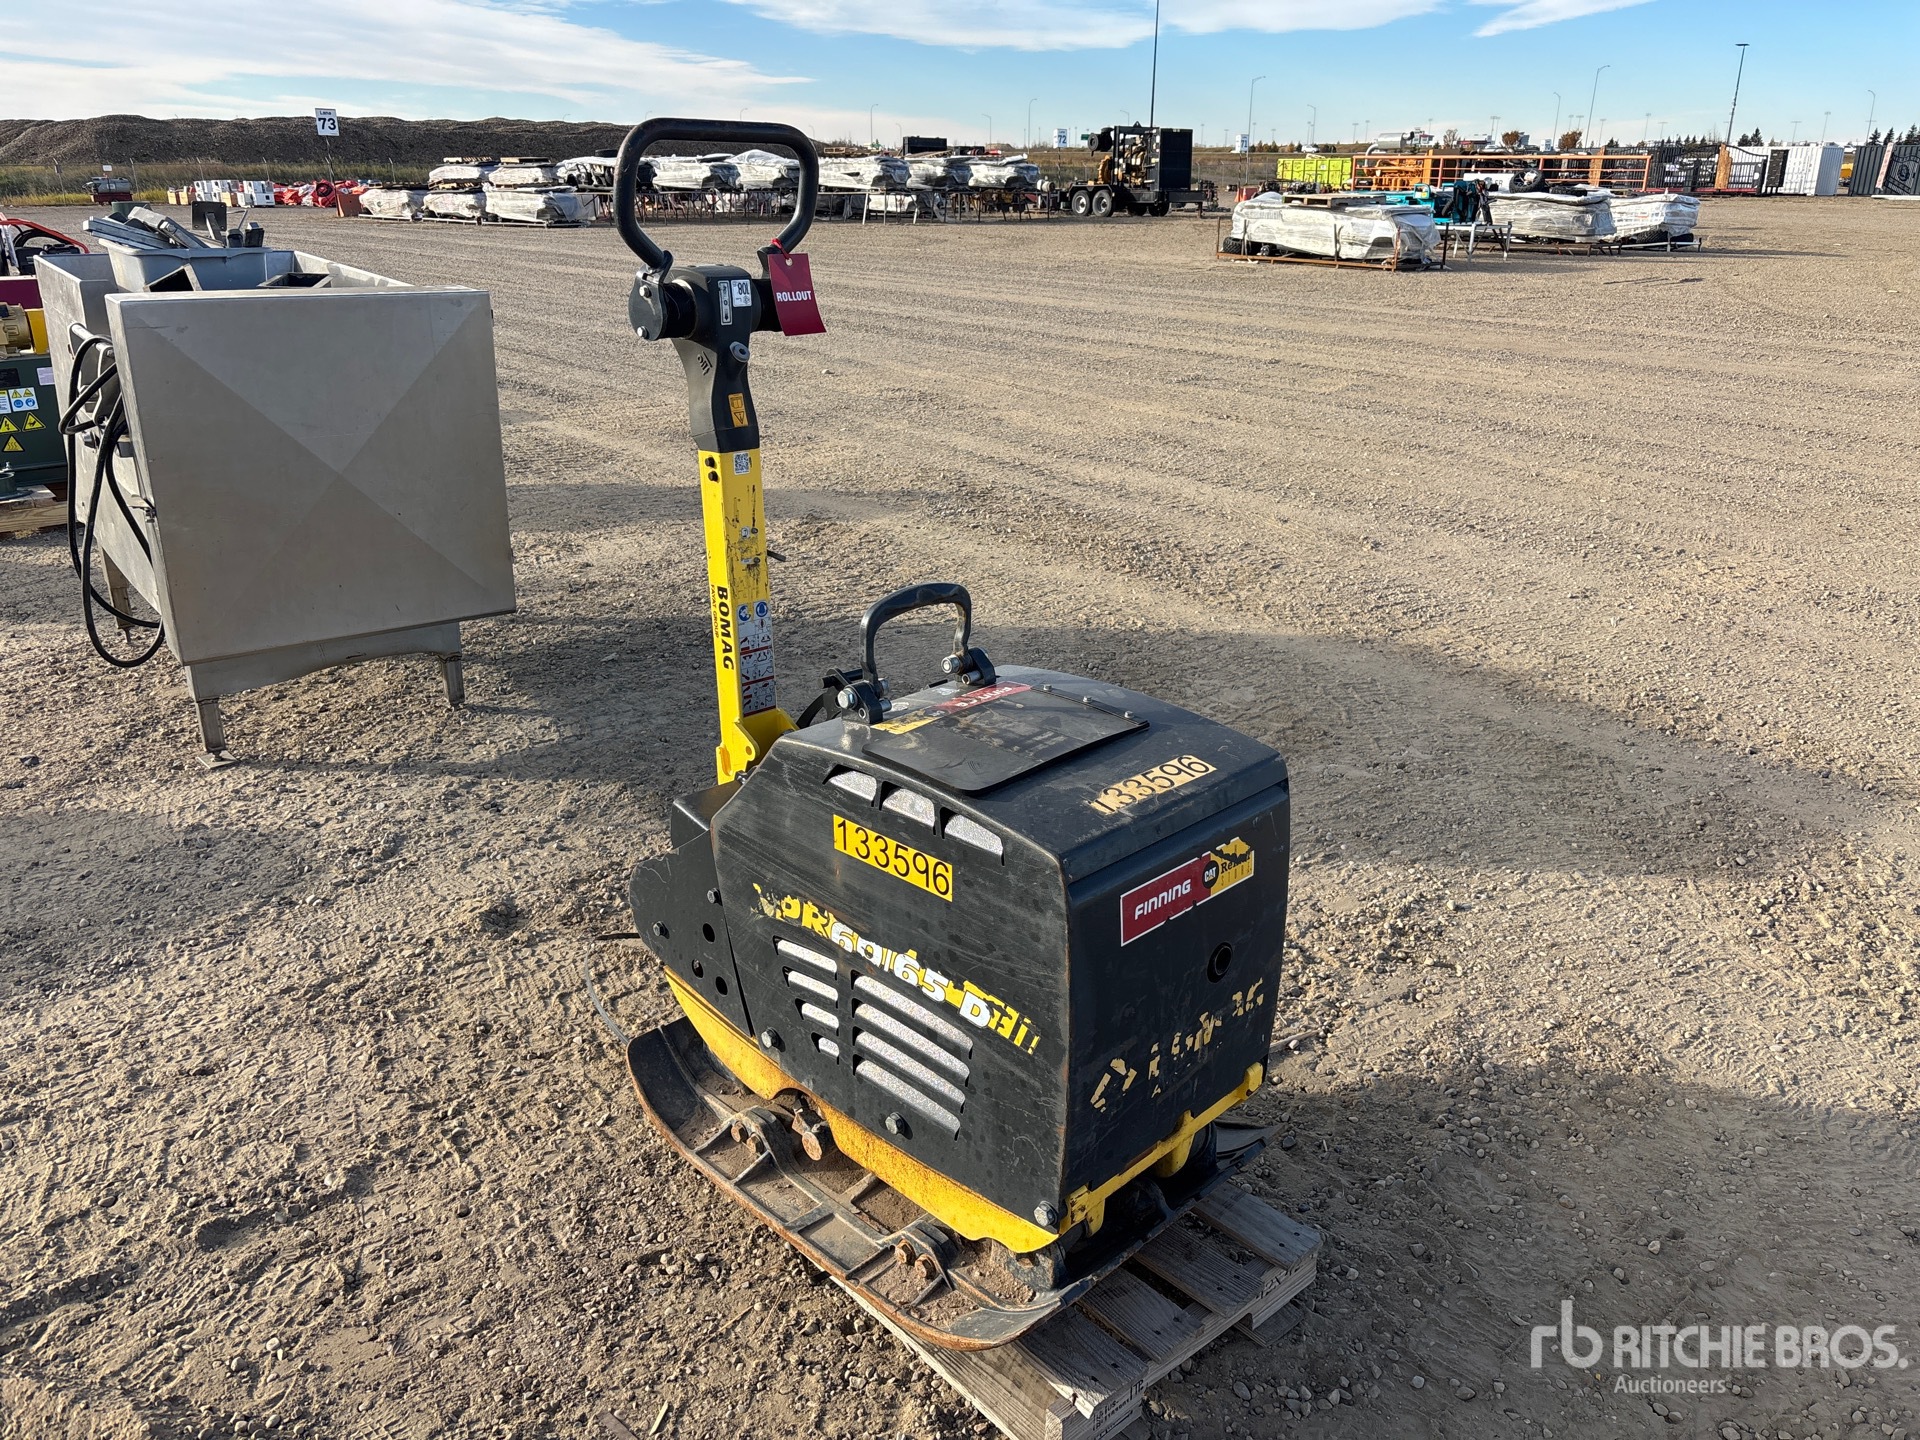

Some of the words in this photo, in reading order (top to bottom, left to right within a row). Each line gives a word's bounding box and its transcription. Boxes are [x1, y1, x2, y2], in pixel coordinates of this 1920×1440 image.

[318, 118, 336, 130] 73
[1058, 135, 1066, 143] 72
[776, 290, 812, 302] ROLLOUT
[717, 586, 734, 670] BOMAG
[1094, 756, 1210, 812] 133596
[837, 819, 950, 896] 133596
[1135, 879, 1191, 920] FINNING
[1204, 867, 1216, 882] CAT
